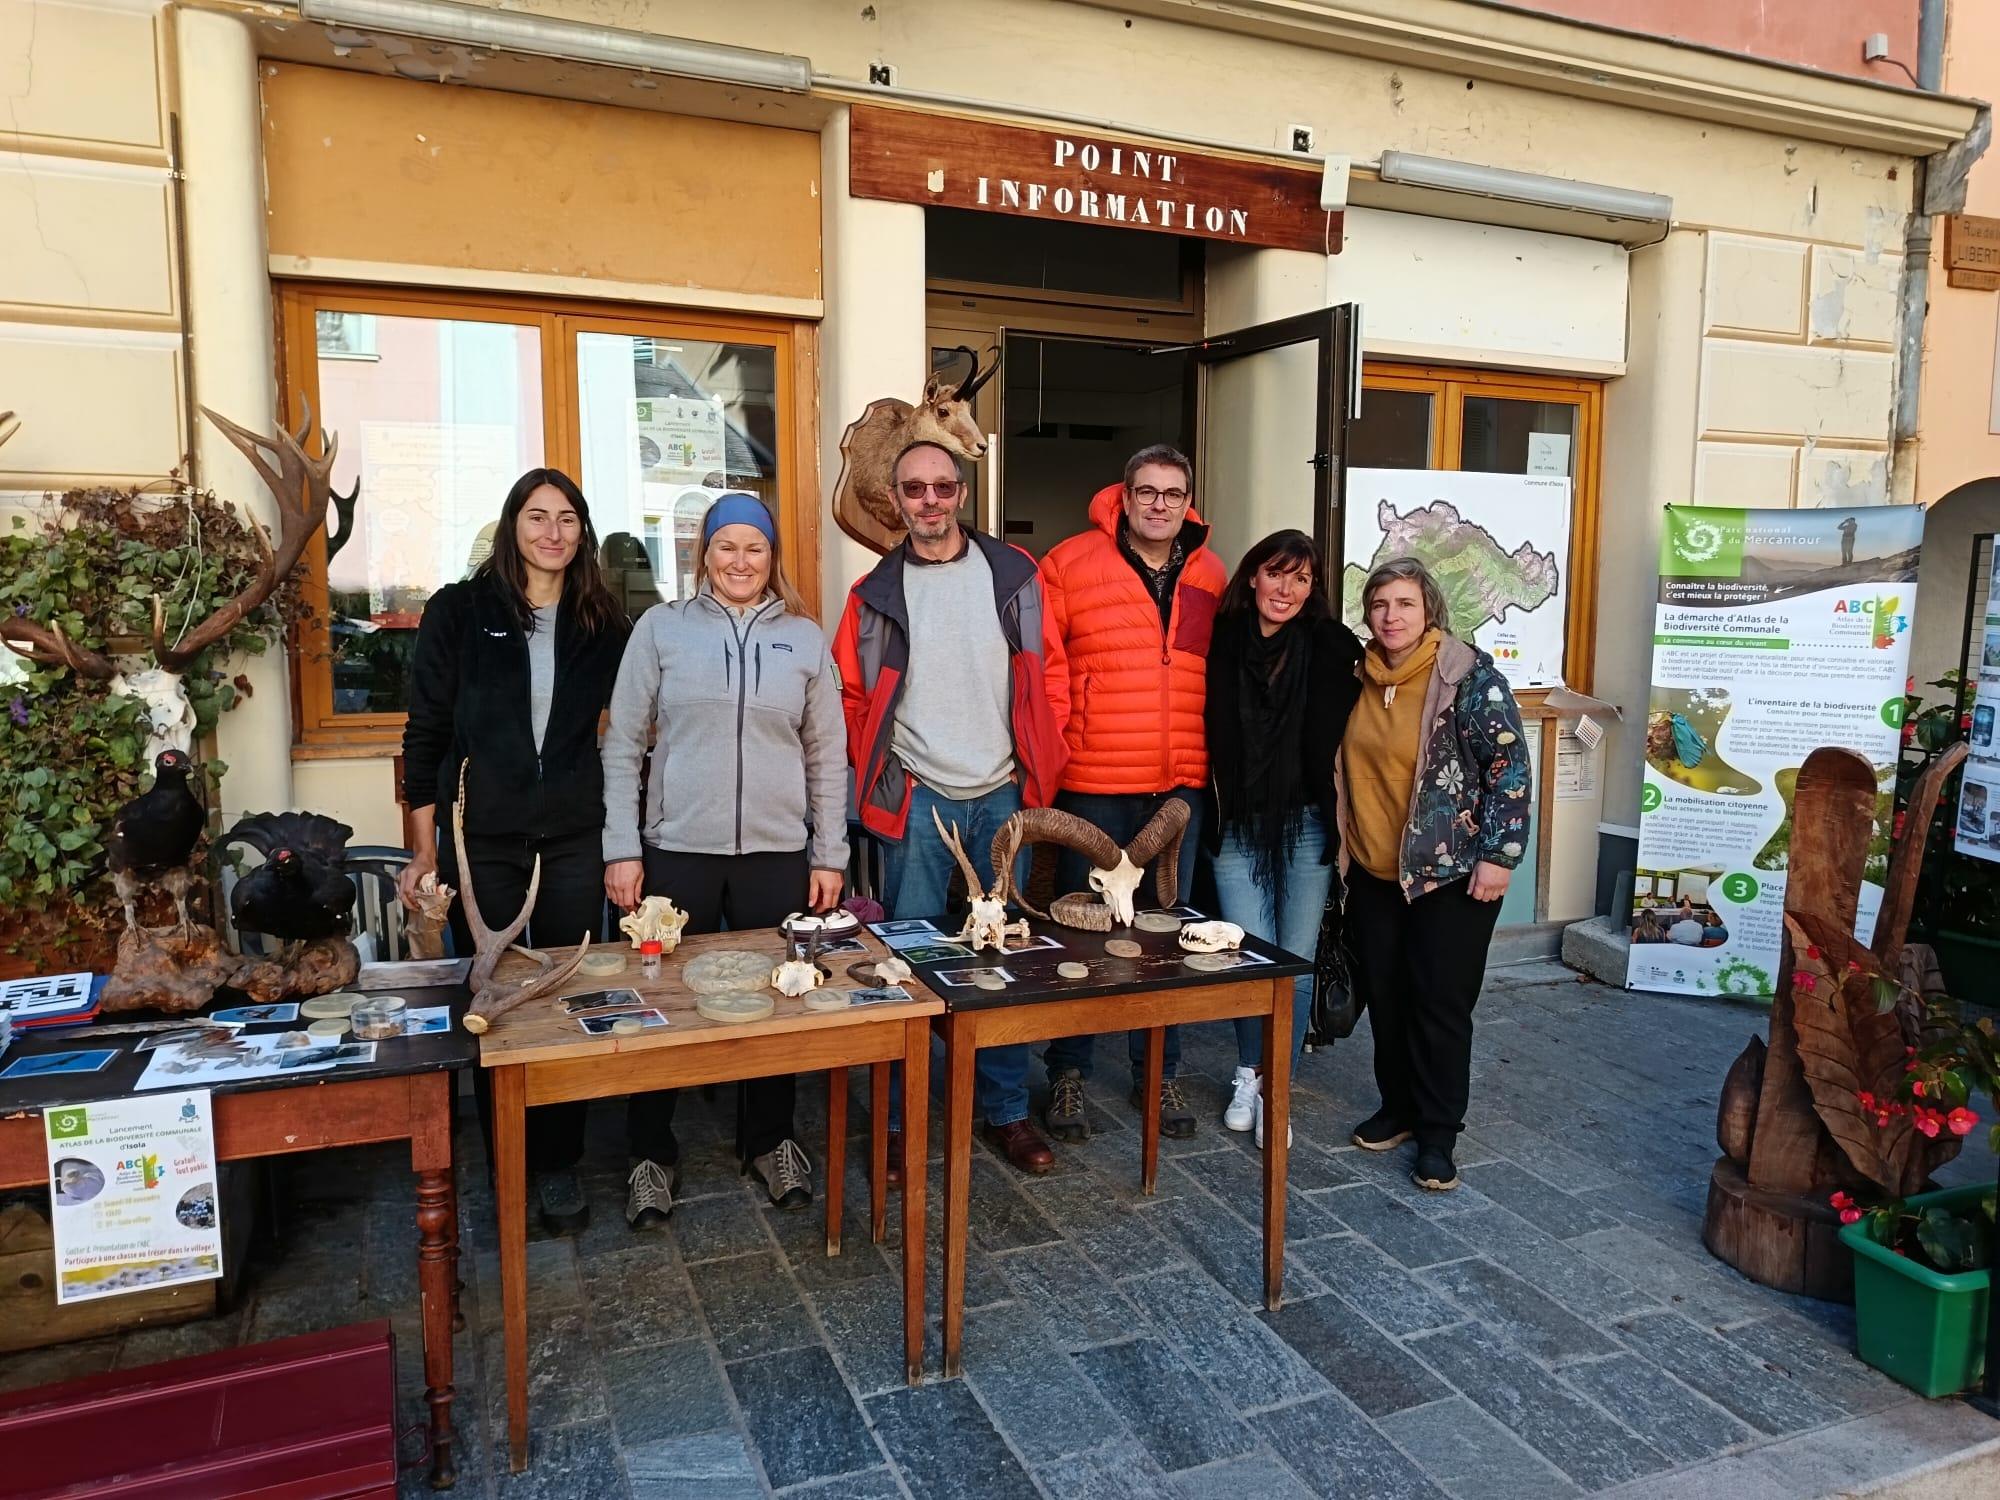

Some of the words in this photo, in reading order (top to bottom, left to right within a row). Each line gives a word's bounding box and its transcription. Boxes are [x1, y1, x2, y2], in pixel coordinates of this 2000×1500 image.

[1054, 139, 1178, 183] POINT
[976, 176, 1248, 237] INFORMATION
[668, 443, 683, 451] ABC
[1745, 526, 1791, 534] national
[1744, 536, 1821, 545] Mercantour
[1666, 582, 1706, 590] Connaître
[1708, 582, 1716, 591] la
[1717, 583, 1770, 593] biodiversité,
[1666, 592, 1685, 600] c'est
[1686, 592, 1712, 600] mieux
[1714, 592, 1722, 600] la
[1724, 592, 1761, 602] protéger
[1834, 600, 1874, 614] ABC
[1664, 613, 1675, 621] La
[1678, 613, 1724, 622] démarche
[1727, 614, 1761, 624] d'Atlas
[1764, 616, 1777, 624] de
[1780, 616, 1789, 624] la
[1664, 622, 1720, 632] Biodiversité
[1722, 624, 1781, 634] Communale
[1748, 698, 1798, 708] L'inventaire
[1824, 702, 1877, 711] biodiversité
[1766, 708, 1800, 716] Connaître
[1802, 710, 1818, 718] pour
[1844, 712, 1876, 720] protéger
[1889, 704, 1900, 722] 1
[1644, 789, 1656, 806] 2
[1675, 796, 1726, 807] mobilisation
[1728, 801, 1768, 810] citoyenne
[1723, 809, 1763, 818] biodiversité
[1733, 880, 1748, 897] 3
[1761, 882, 1784, 892] Place
[109, 1122, 153, 1135] Lancement
[60, 1140, 82, 1149] ATLAS
[84, 1138, 94, 1146] DE
[95, 1137, 104, 1145] LA
[156, 1126, 202, 1138] COMMUNALE
[120, 1142, 146, 1151] d'Isola
[116, 1158, 143, 1170] ABC
[64, 1254, 97, 1265] Participez
[147, 1248, 167, 1257] trésor
[168, 1246, 183, 1255] dans
[190, 1243, 211, 1254] village
